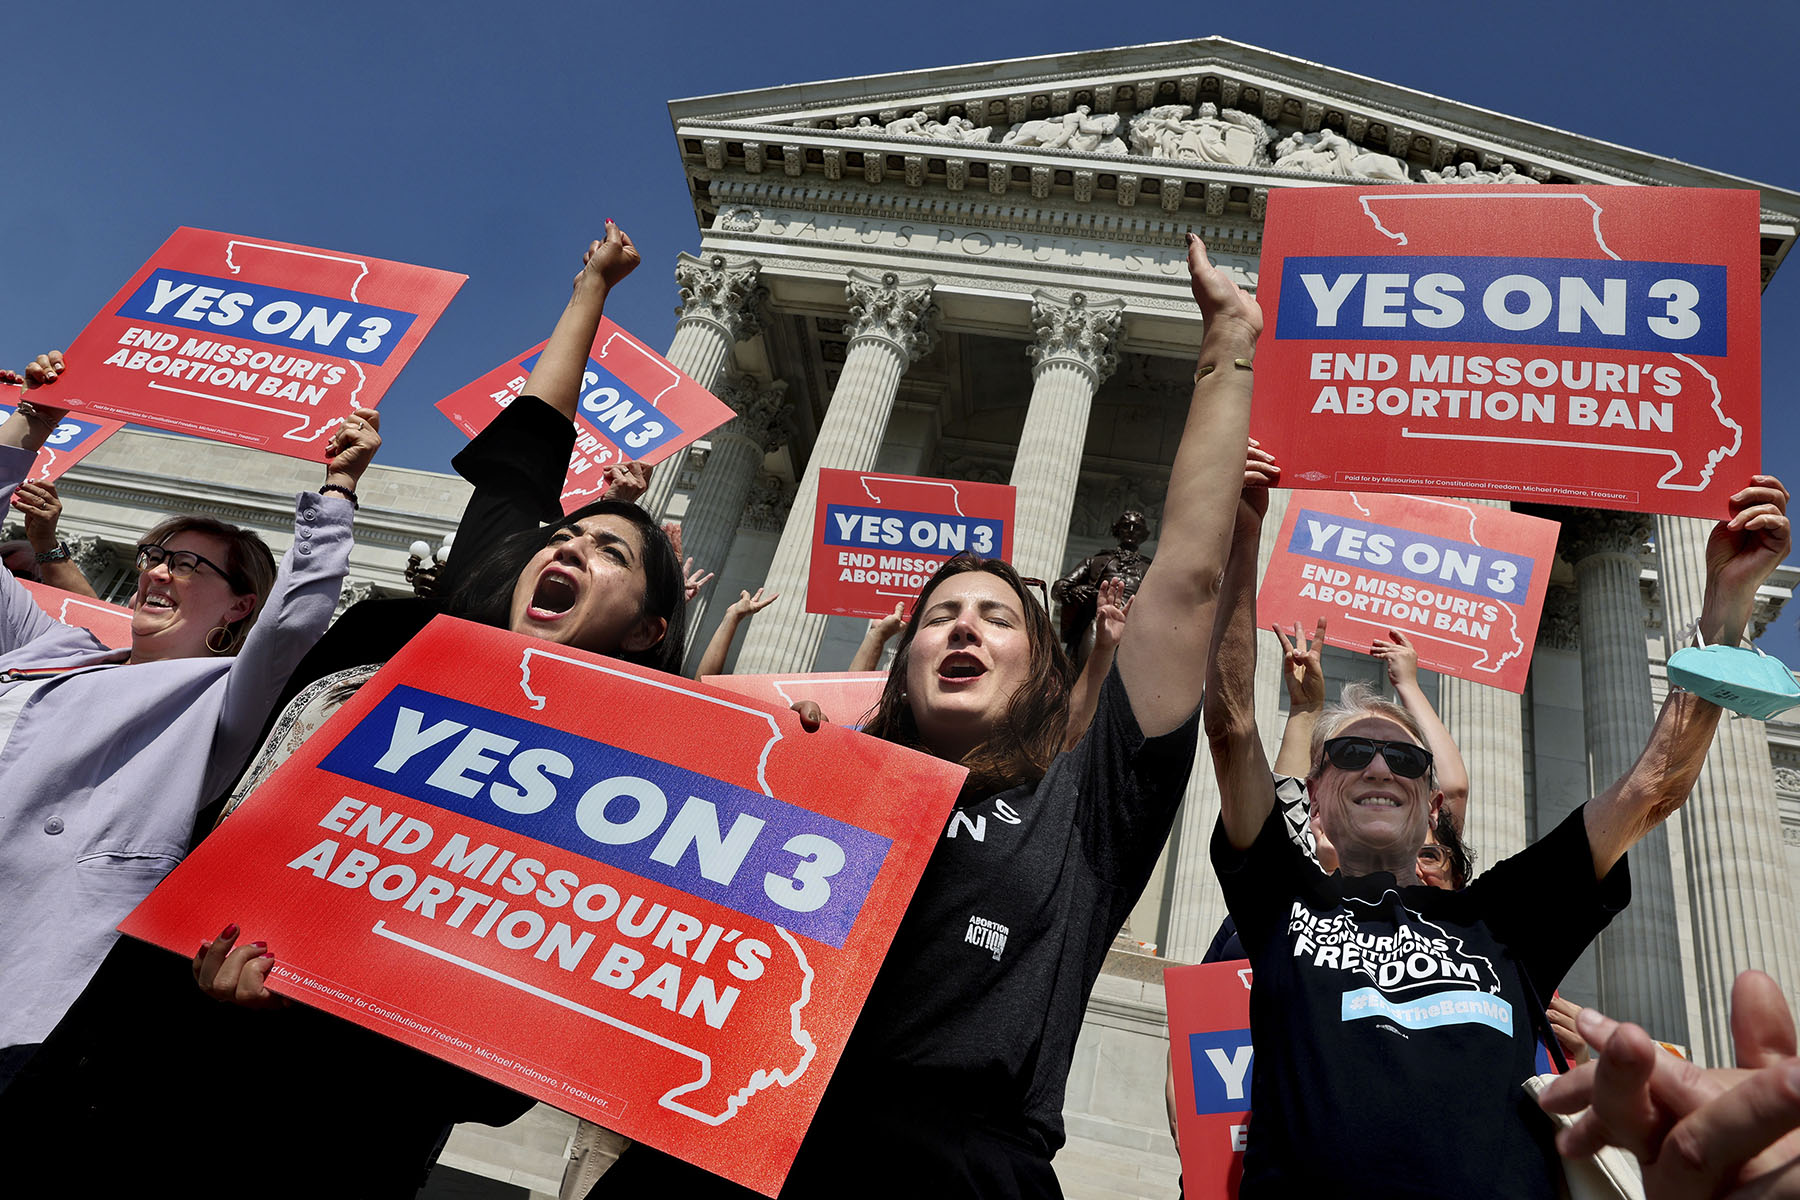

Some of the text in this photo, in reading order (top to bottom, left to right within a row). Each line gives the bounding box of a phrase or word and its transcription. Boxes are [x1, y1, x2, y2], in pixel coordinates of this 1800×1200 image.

[146, 280, 391, 353] YES ON 3
[1300, 273, 1700, 339] YES ON 3
[104, 349, 328, 405] ABORTION BAN
[118, 328, 346, 385] END MISSOURI'S
[1310, 353, 1681, 396] END MISSOURI'S
[506, 376, 527, 395] EN
[1312, 387, 1673, 432] ABORTION BAN
[46, 423, 81, 444] 3
[583, 388, 664, 447] ON 3
[1371, 475, 1382, 484] by
[1381, 476, 1424, 485] Missourians
[1435, 479, 1487, 488] Constitutional
[1487, 482, 1522, 492] Freedom,
[1523, 485, 1552, 493] Michael
[1553, 487, 1589, 497] Pridmore,
[1590, 490, 1628, 500] Treasurer.
[835, 513, 992, 553] YES ON 3
[1306, 519, 1517, 593] YES ON 3
[839, 552, 944, 573] END MISSO
[1299, 580, 1490, 640] ABORTION BAN
[1301, 564, 1498, 624] END MISSOURI'S
[374, 707, 845, 912] YES ON 3
[318, 796, 772, 983] END MISSOURI'S
[287, 839, 742, 1030] ABORTION BAN
[969, 915, 1010, 936] ABORTION
[1287, 920, 1314, 940] FOR
[278, 967, 609, 1109] for by Missourians for Constitutional Freedom, Michael Pridmore, Treasurer.
